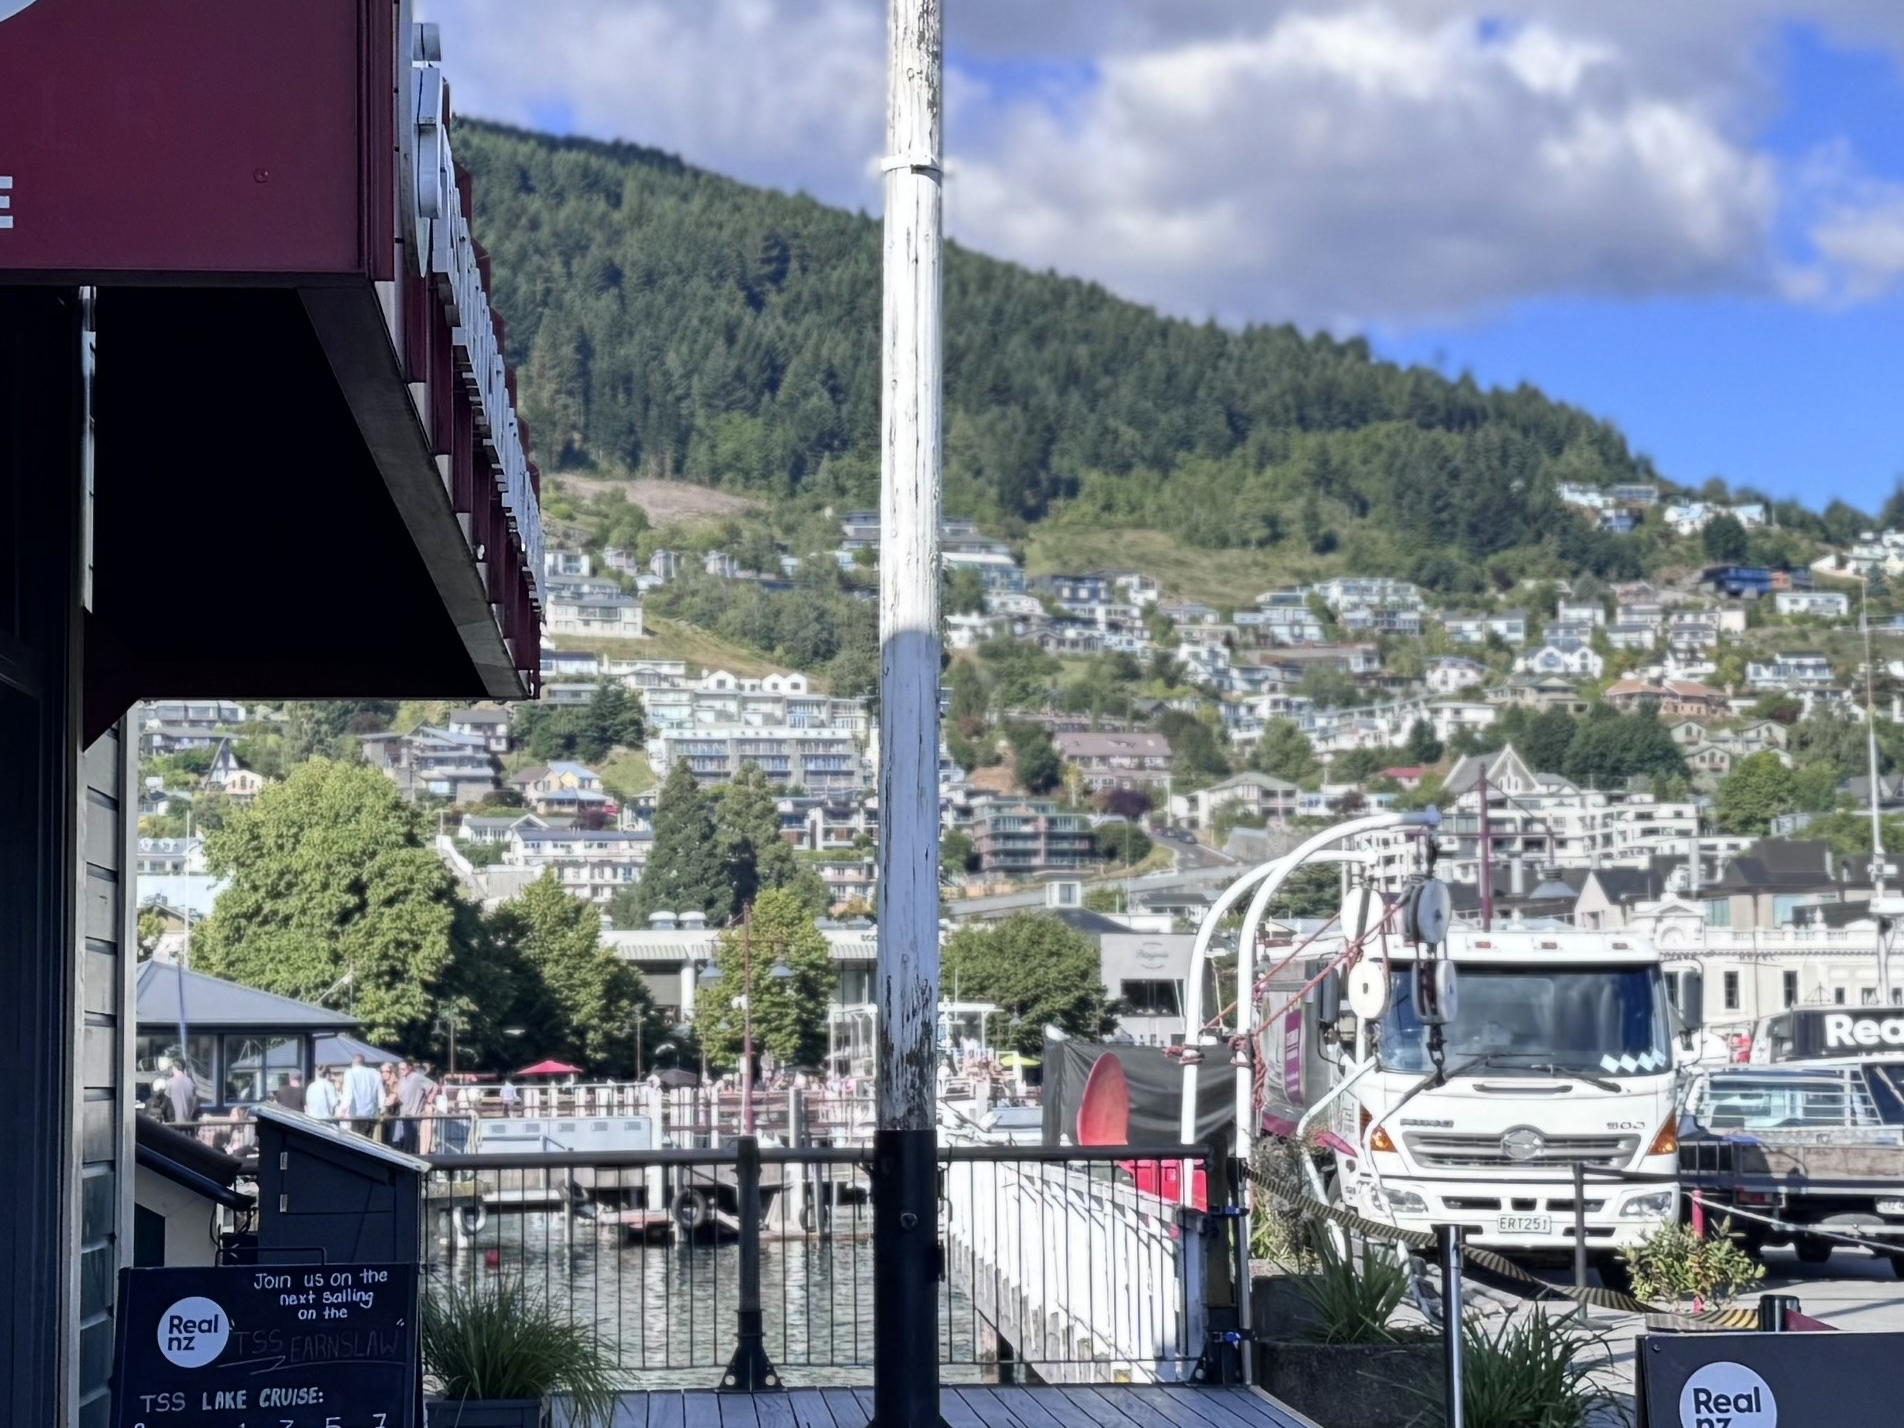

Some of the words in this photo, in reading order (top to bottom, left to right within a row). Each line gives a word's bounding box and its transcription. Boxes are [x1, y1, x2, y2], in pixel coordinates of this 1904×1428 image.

[1499, 1217, 1547, 1230] ERT251
[254, 1273, 291, 1289] Join
[304, 1274, 324, 1287] us
[330, 1273, 352, 1286] on
[360, 1268, 388, 1284] the
[280, 1292, 316, 1306] next
[298, 1308, 316, 1320] on
[323, 1306, 348, 1319] the
[168, 1314, 219, 1334] Real
[167, 1336, 195, 1351] nz
[140, 1392, 186, 1413] TSS
[202, 1389, 247, 1410] LAKE
[259, 1387, 324, 1408] CRUISE:
[1692, 1386, 1761, 1415] Real
